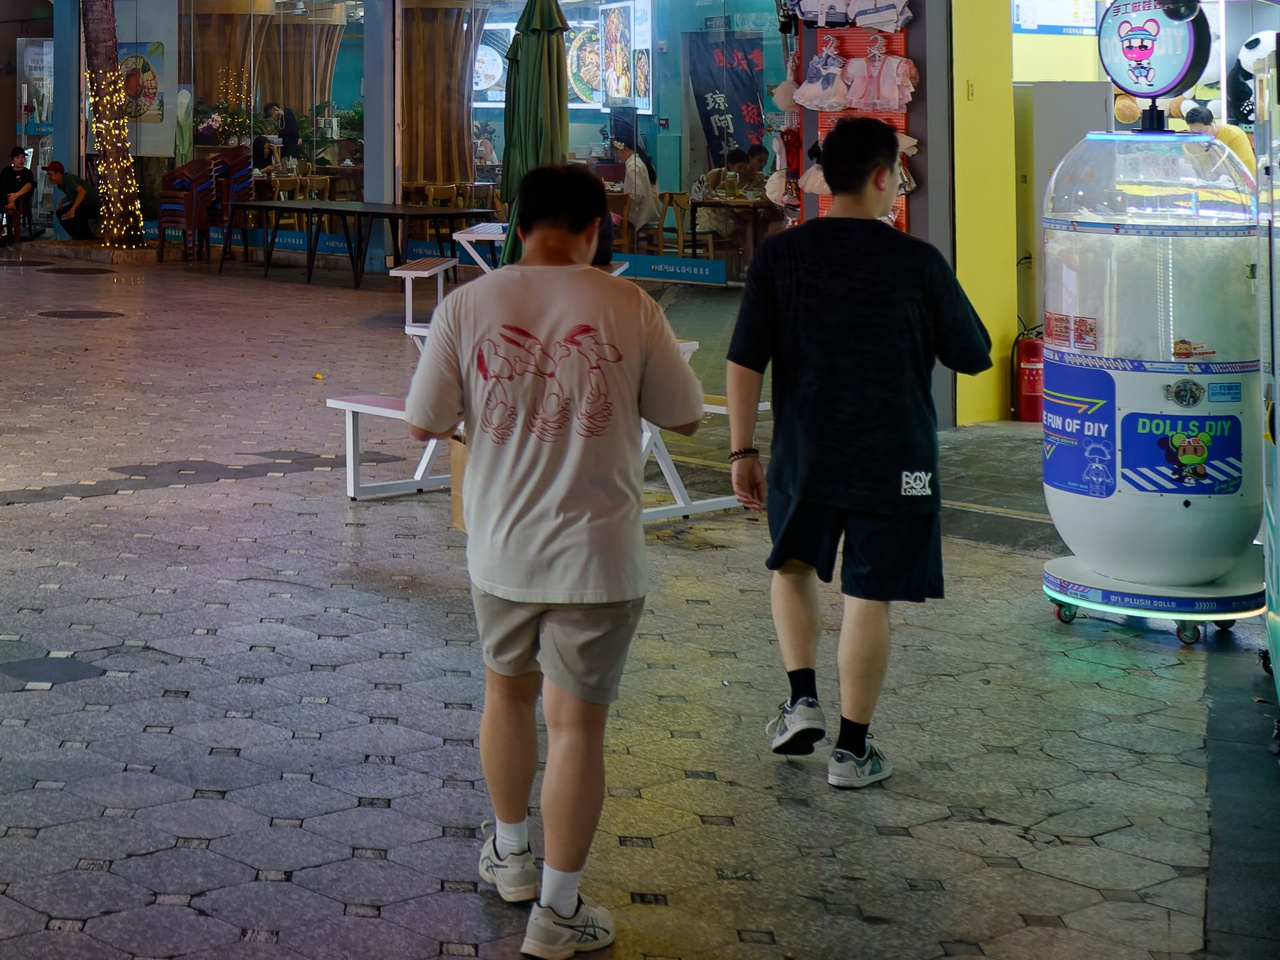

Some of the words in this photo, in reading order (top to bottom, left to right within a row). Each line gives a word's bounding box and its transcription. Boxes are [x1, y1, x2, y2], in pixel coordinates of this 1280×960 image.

[1047, 416, 1063, 431] FUN
[1065, 419, 1081, 434] OF
[1084, 422, 1109, 438] DIY
[1137, 418, 1200, 436] DOLLS
[1203, 420, 1232, 437] DIY
[902, 471, 932, 489] BOY
[901, 488, 932, 496] LONDON
[1110, 595, 1122, 603] DIY
[1124, 597, 1151, 606] PLUSH
[1153, 600, 1177, 608] DOLLS
